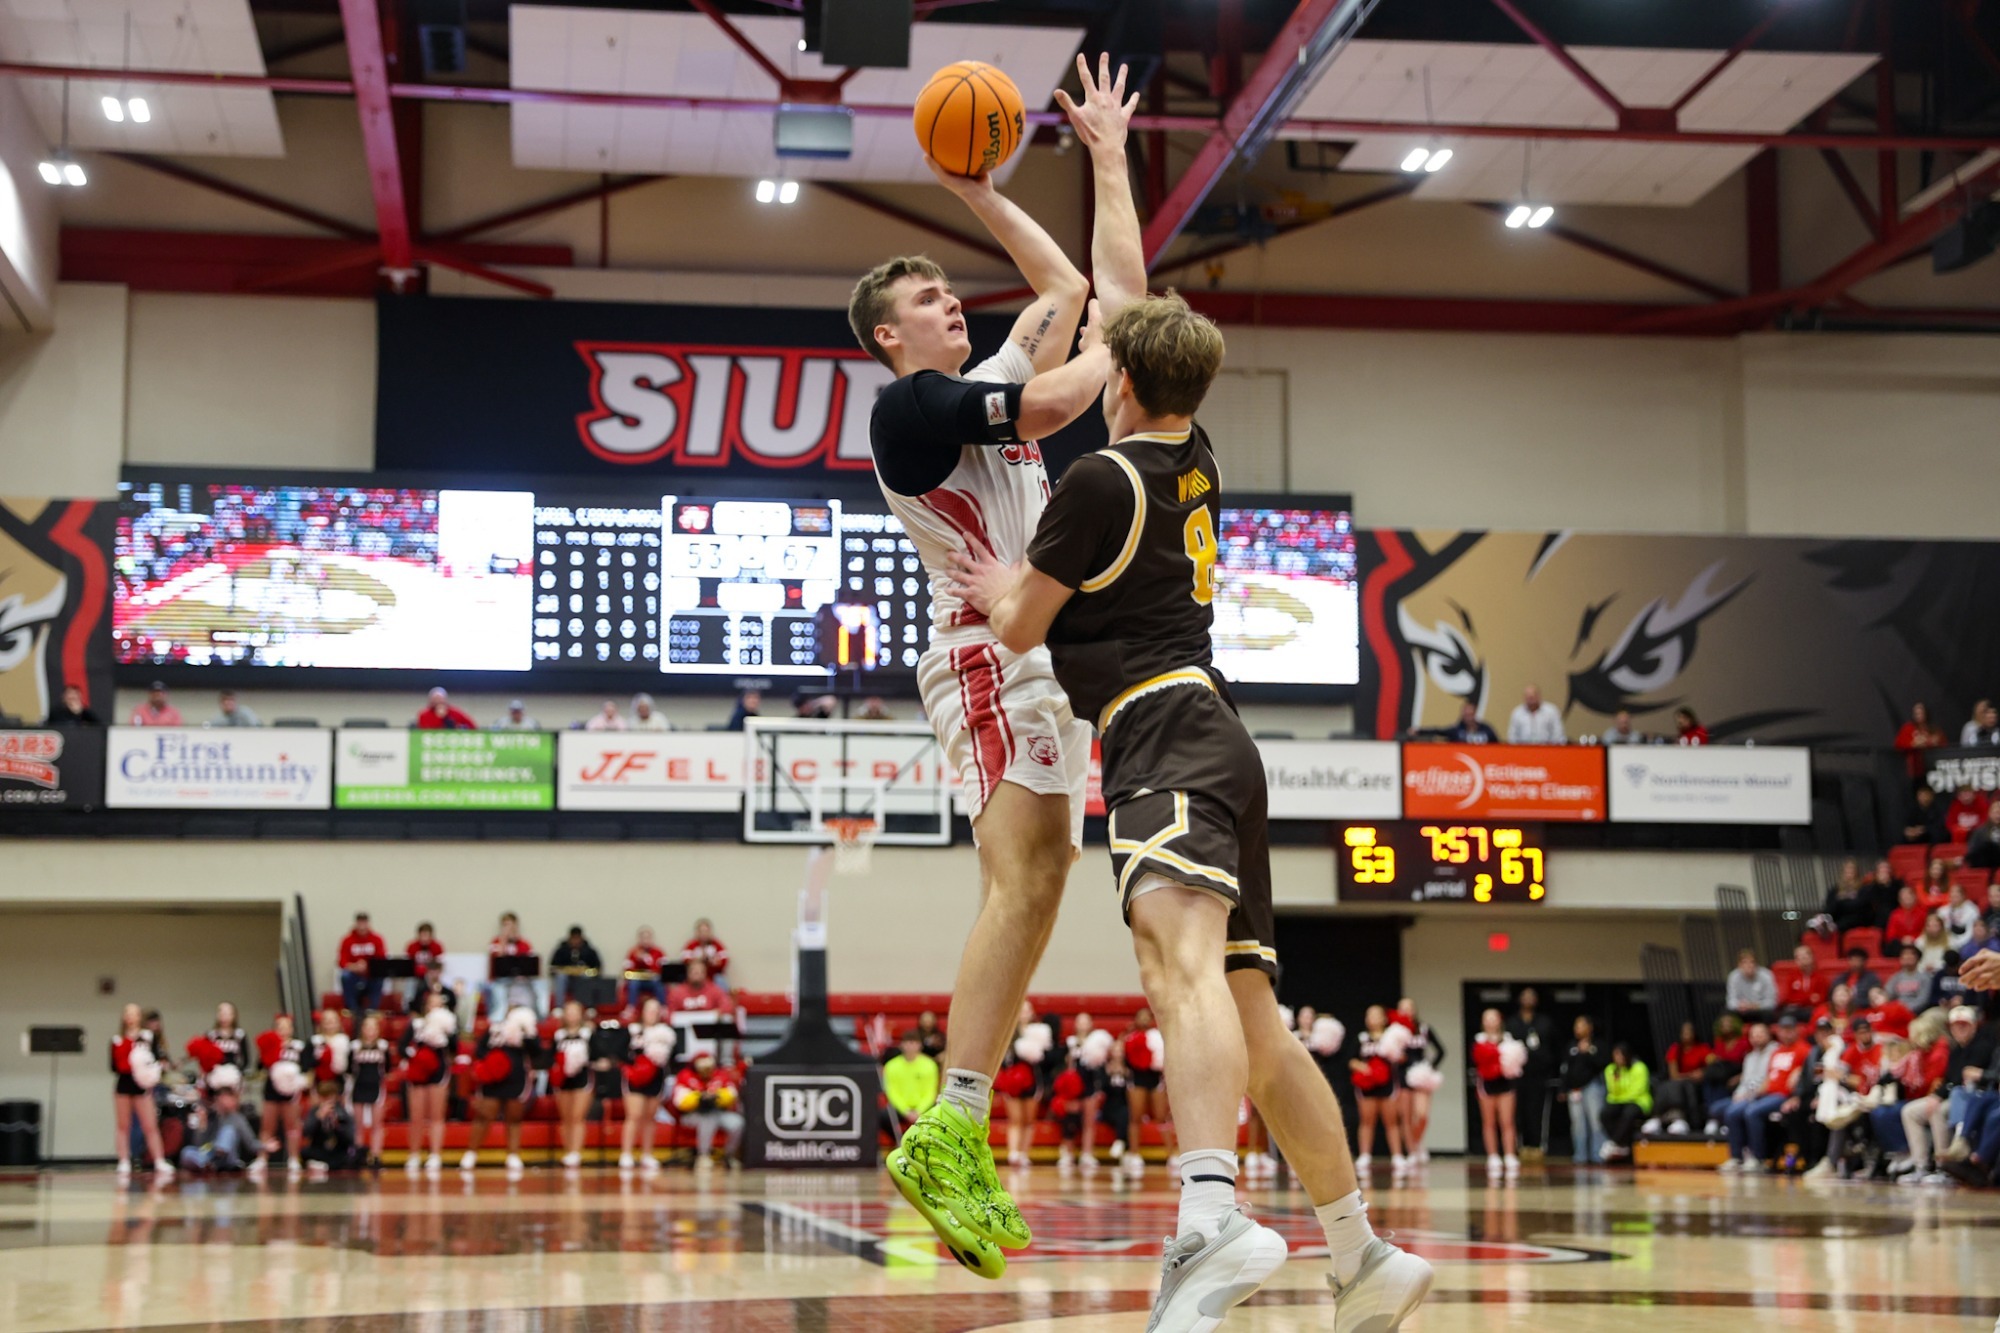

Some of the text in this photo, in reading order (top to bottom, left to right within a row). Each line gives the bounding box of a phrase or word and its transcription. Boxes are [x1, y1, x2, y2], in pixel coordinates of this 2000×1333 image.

[1183, 503, 1218, 607] 8
[155, 733, 231, 764] First
[421, 733, 542, 751] SCORE WITH
[421, 750, 497, 766] ENERGY
[667, 758, 964, 784] ELECTRIC
[119, 748, 318, 802] Community
[1926, 770, 2000, 794] DIVIS
[1419, 826, 1489, 863] 7:57
[1352, 846, 1395, 884] 53
[1500, 847, 1544, 885] 67
[1424, 880, 1468, 900] period
[1473, 873, 1493, 903] 2
[777, 1087, 850, 1132] BJC
[764, 1140, 862, 1162] HealthCare
